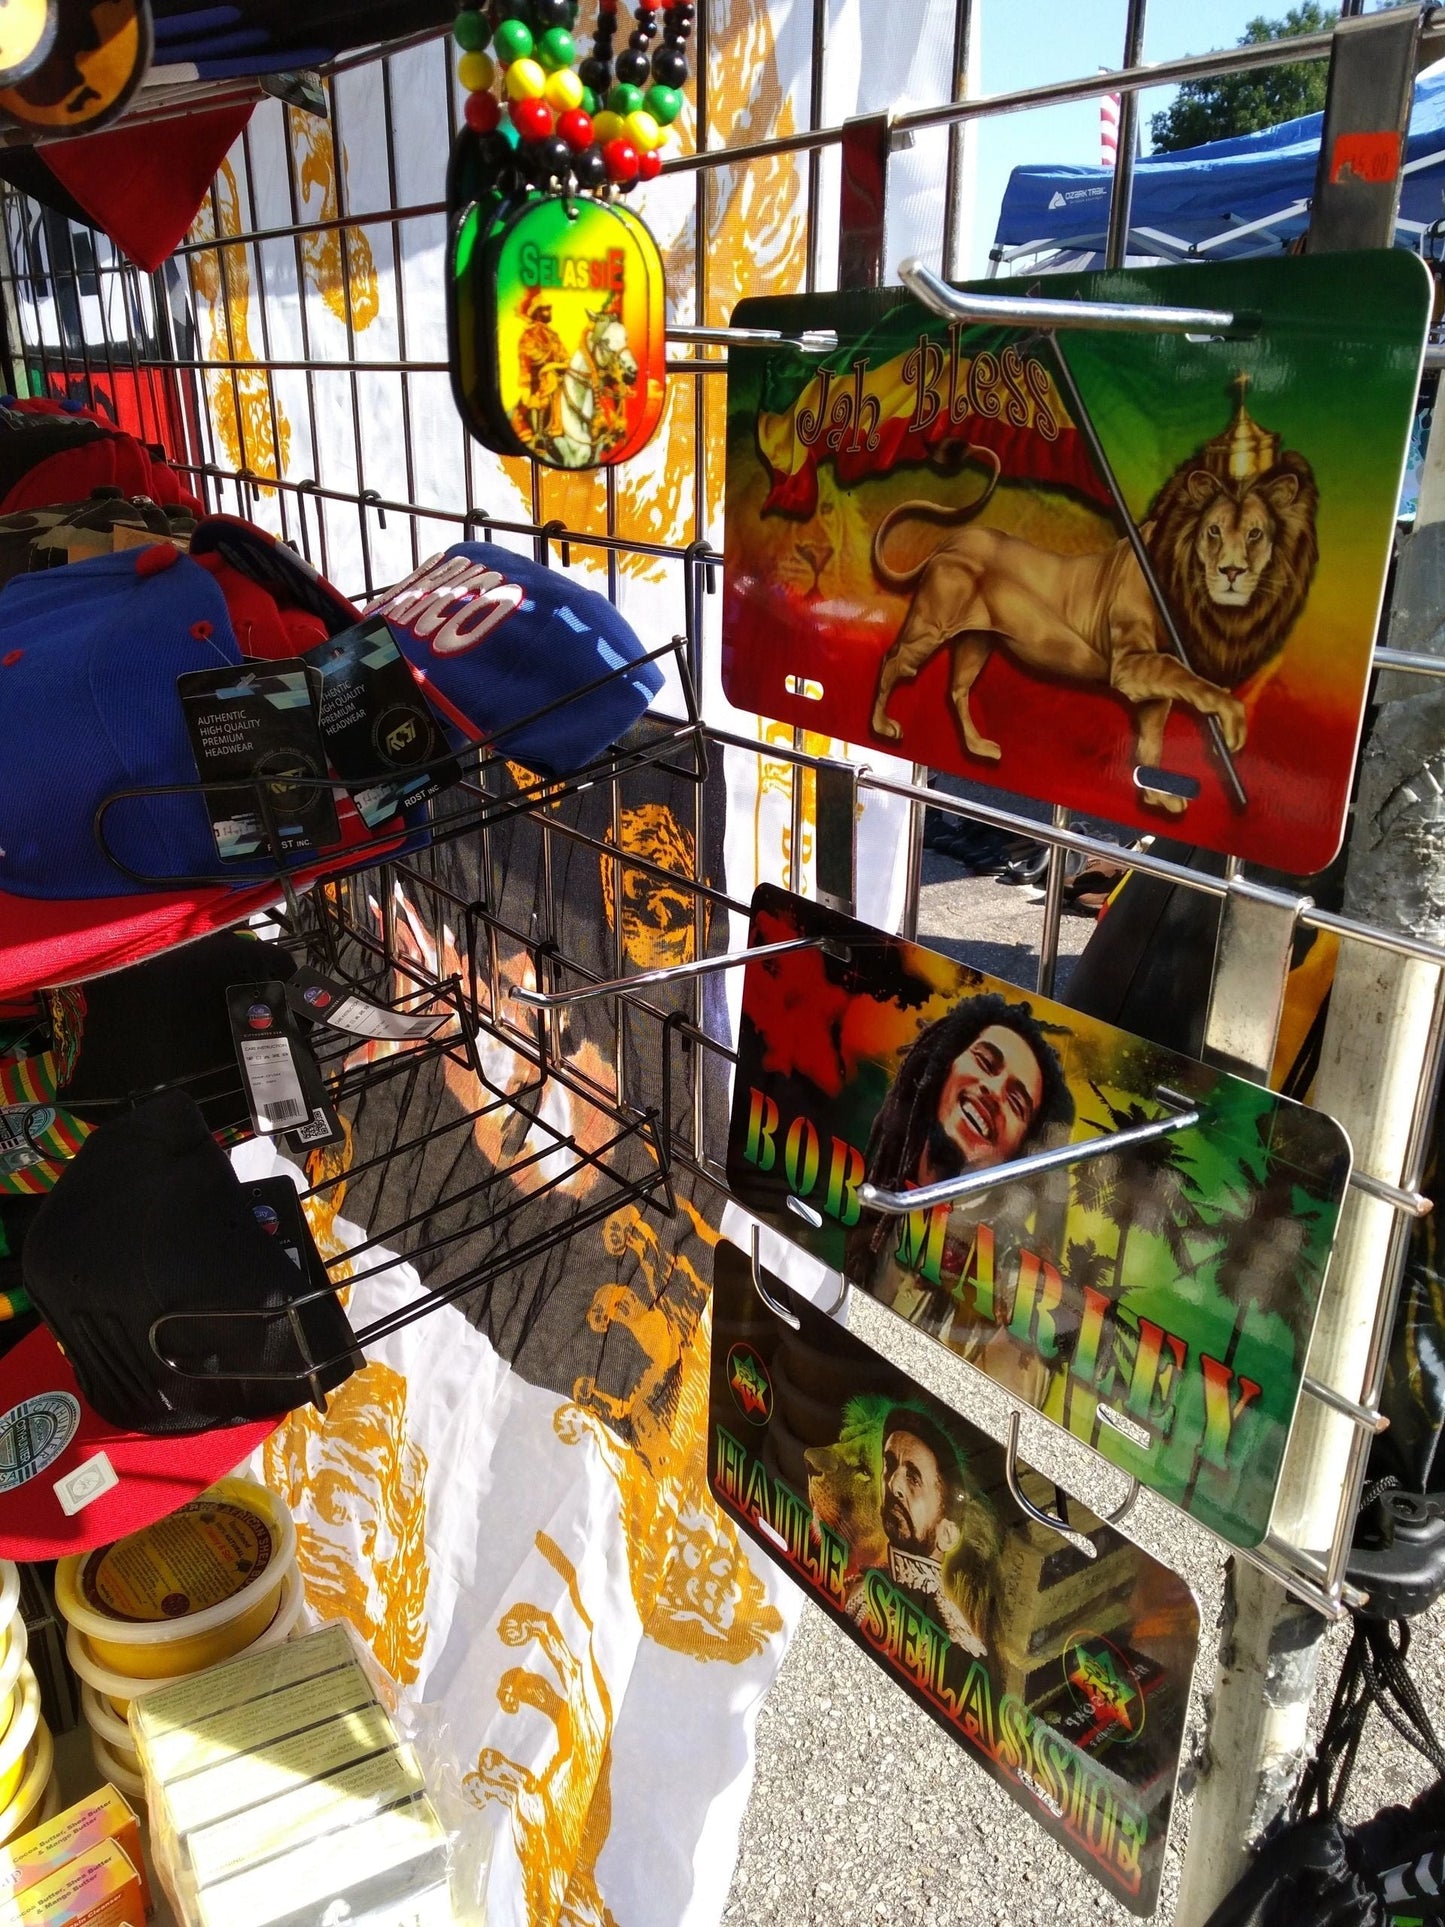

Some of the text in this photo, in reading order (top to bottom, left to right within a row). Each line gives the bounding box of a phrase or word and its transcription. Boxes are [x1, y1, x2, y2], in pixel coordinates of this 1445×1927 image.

[796, 321, 1059, 453] Jah Bless
[336, 684, 366, 707] QUALITY
[197, 710, 248, 726] AUTHENTIC
[200, 719, 262, 737] HIGH QUALITY
[320, 702, 356, 726] PREMIUM
[326, 709, 368, 736] HEADWEAR
[202, 733, 244, 747] PREMIUM
[204, 742, 254, 758] HEADWEAR
[404, 790, 427, 807] RDST
[267, 839, 294, 851] RST
[744, 1087, 865, 1226] BOB
[896, 1180, 1262, 1469] MARLEY
[16, 1419, 31, 1463] CITYHUNTER
[714, 1424, 849, 1612] HAILE
[257, 1535, 272, 1568] SHEA
[861, 1569, 1148, 1895] SELASSIE
[13, 1800, 112, 1863] Cocoa Butter, Shea Butter
[46, 1833, 72, 1850] Mango
[73, 1817, 97, 1833] Butter
[38, 1887, 66, 1906] Butter,
[67, 1872, 87, 1887] Shea
[87, 1856, 112, 1874] Butter
[45, 1892, 72, 1909] Mango
[73, 1874, 98, 1891] Butter
[87, 1893, 122, 1918] Cleanser
